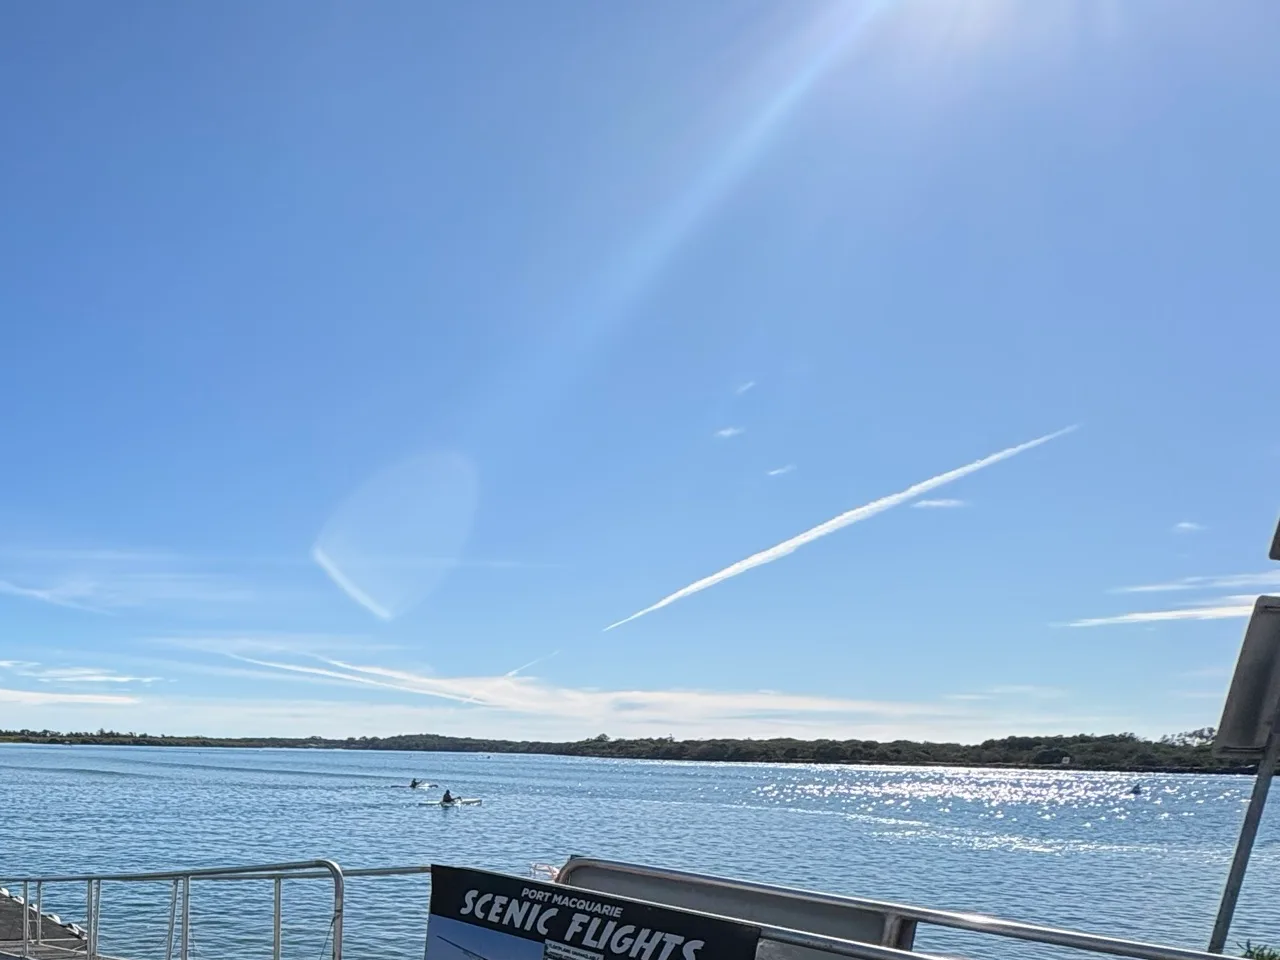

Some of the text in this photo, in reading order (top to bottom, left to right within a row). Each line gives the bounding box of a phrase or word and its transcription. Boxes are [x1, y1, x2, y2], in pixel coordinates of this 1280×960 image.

[459, 889, 560, 936] SCENIC
[521, 887, 624, 918] PORT MACQUARIE
